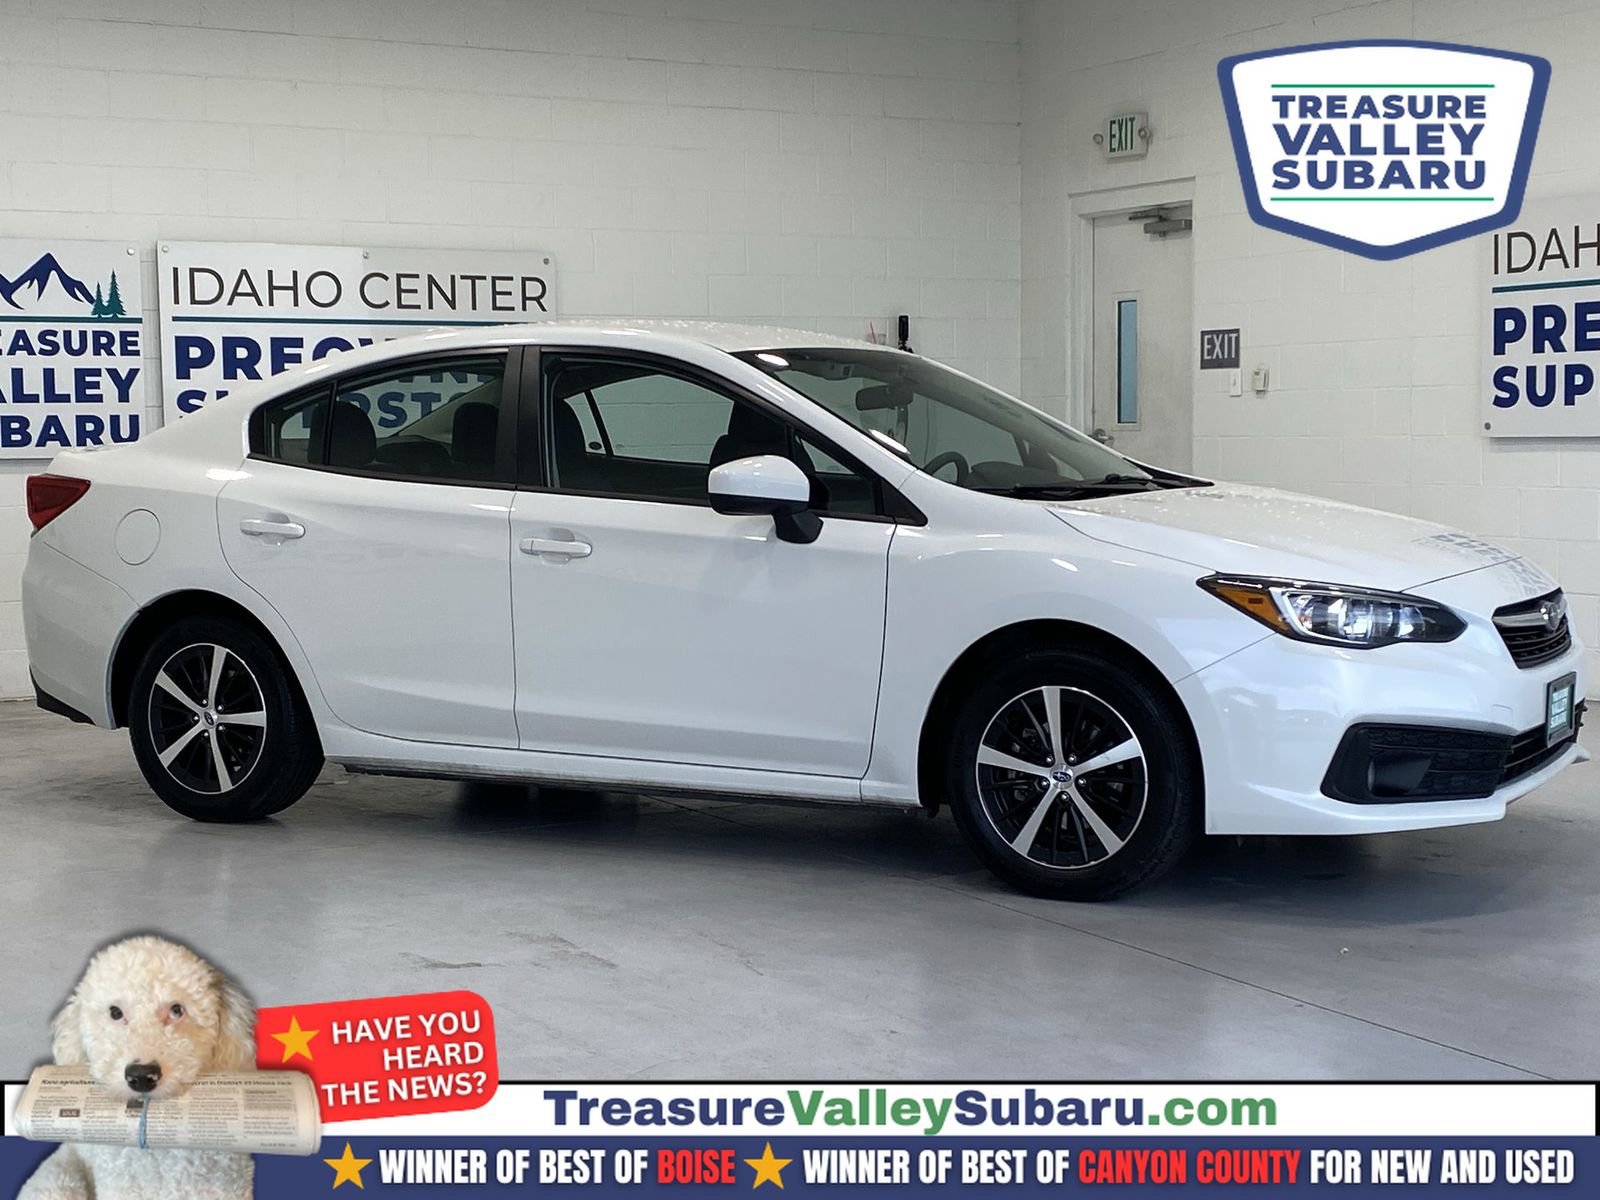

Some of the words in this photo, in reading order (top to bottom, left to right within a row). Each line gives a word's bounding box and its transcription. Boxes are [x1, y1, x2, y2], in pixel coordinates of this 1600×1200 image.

[1110, 117, 1137, 153] EXIT
[171, 266, 343, 309] IDAHO
[359, 271, 549, 312] CENTER
[0, 329, 141, 357] ASURE
[1203, 333, 1238, 360] EXIT
[1493, 301, 1600, 356] PRE
[0, 367, 141, 404] LLEY
[1492, 363, 1595, 409] SUP
